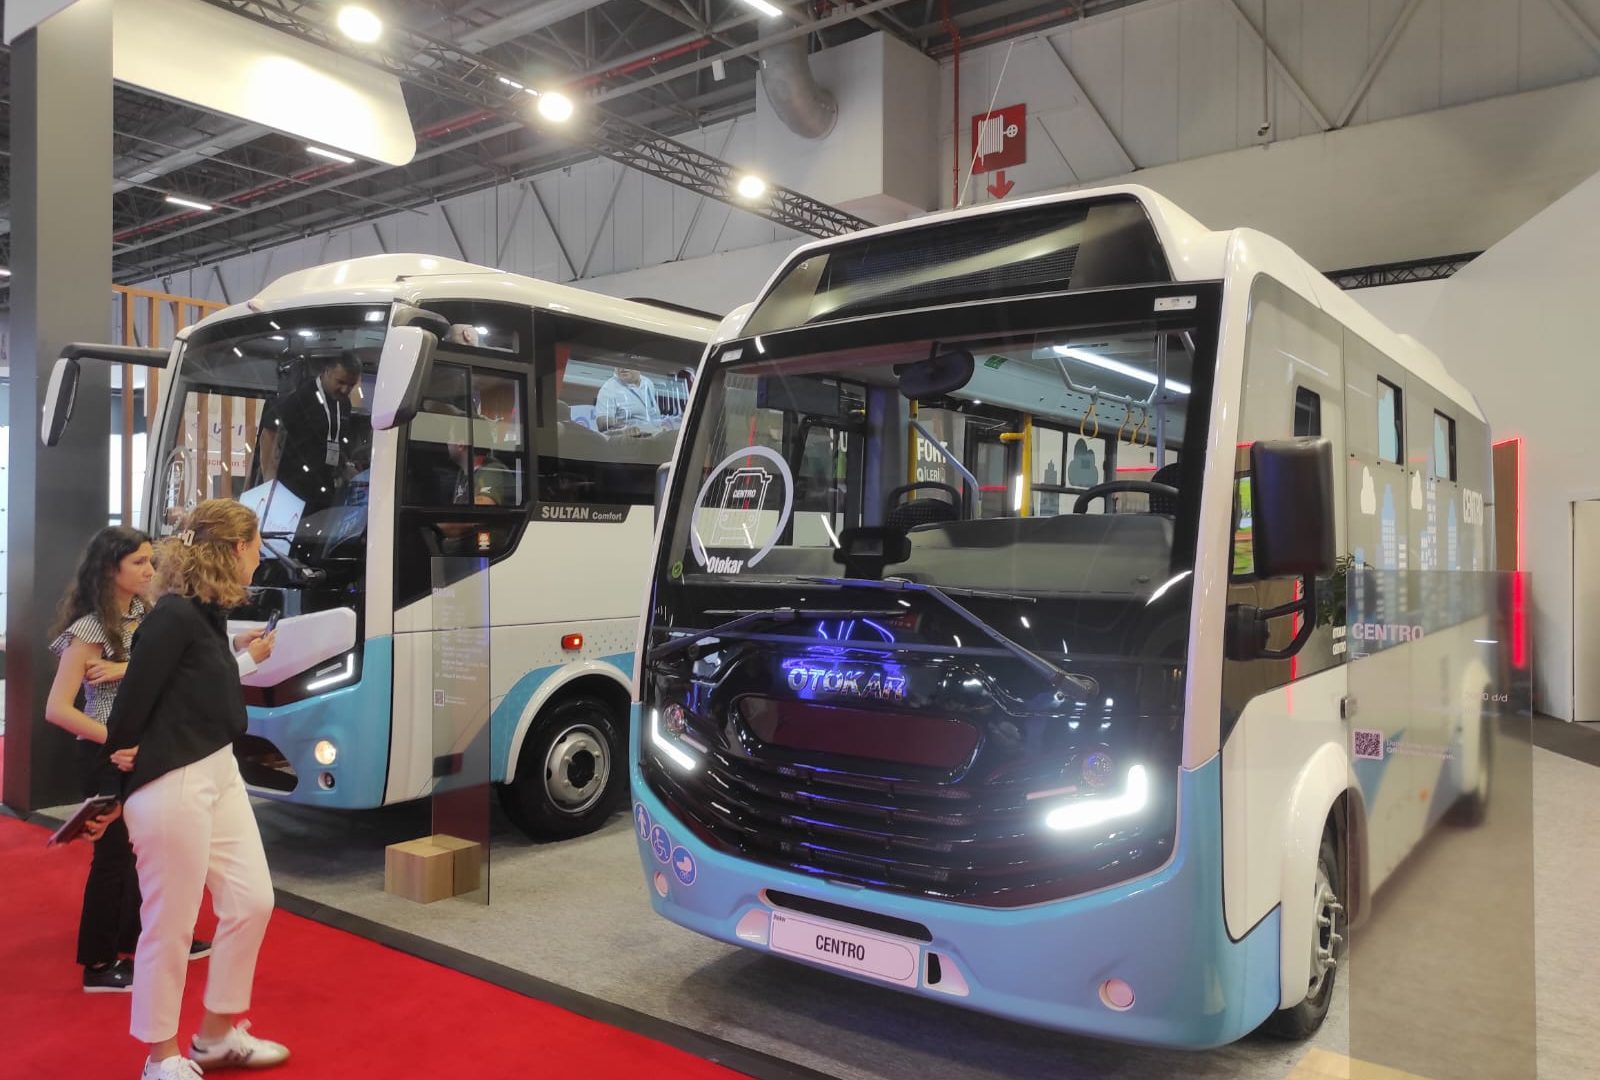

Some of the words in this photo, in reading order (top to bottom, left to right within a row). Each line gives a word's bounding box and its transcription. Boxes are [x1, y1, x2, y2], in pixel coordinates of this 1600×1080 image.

[733, 489, 756, 499] CENTRO
[541, 505, 589, 520] SULTAN
[592, 511, 622, 521] Comfort
[707, 556, 744, 574] Otokar
[1351, 622, 1424, 642] CENTRO
[787, 667, 905, 701] OTOKAR
[815, 934, 866, 961] CENTRO
